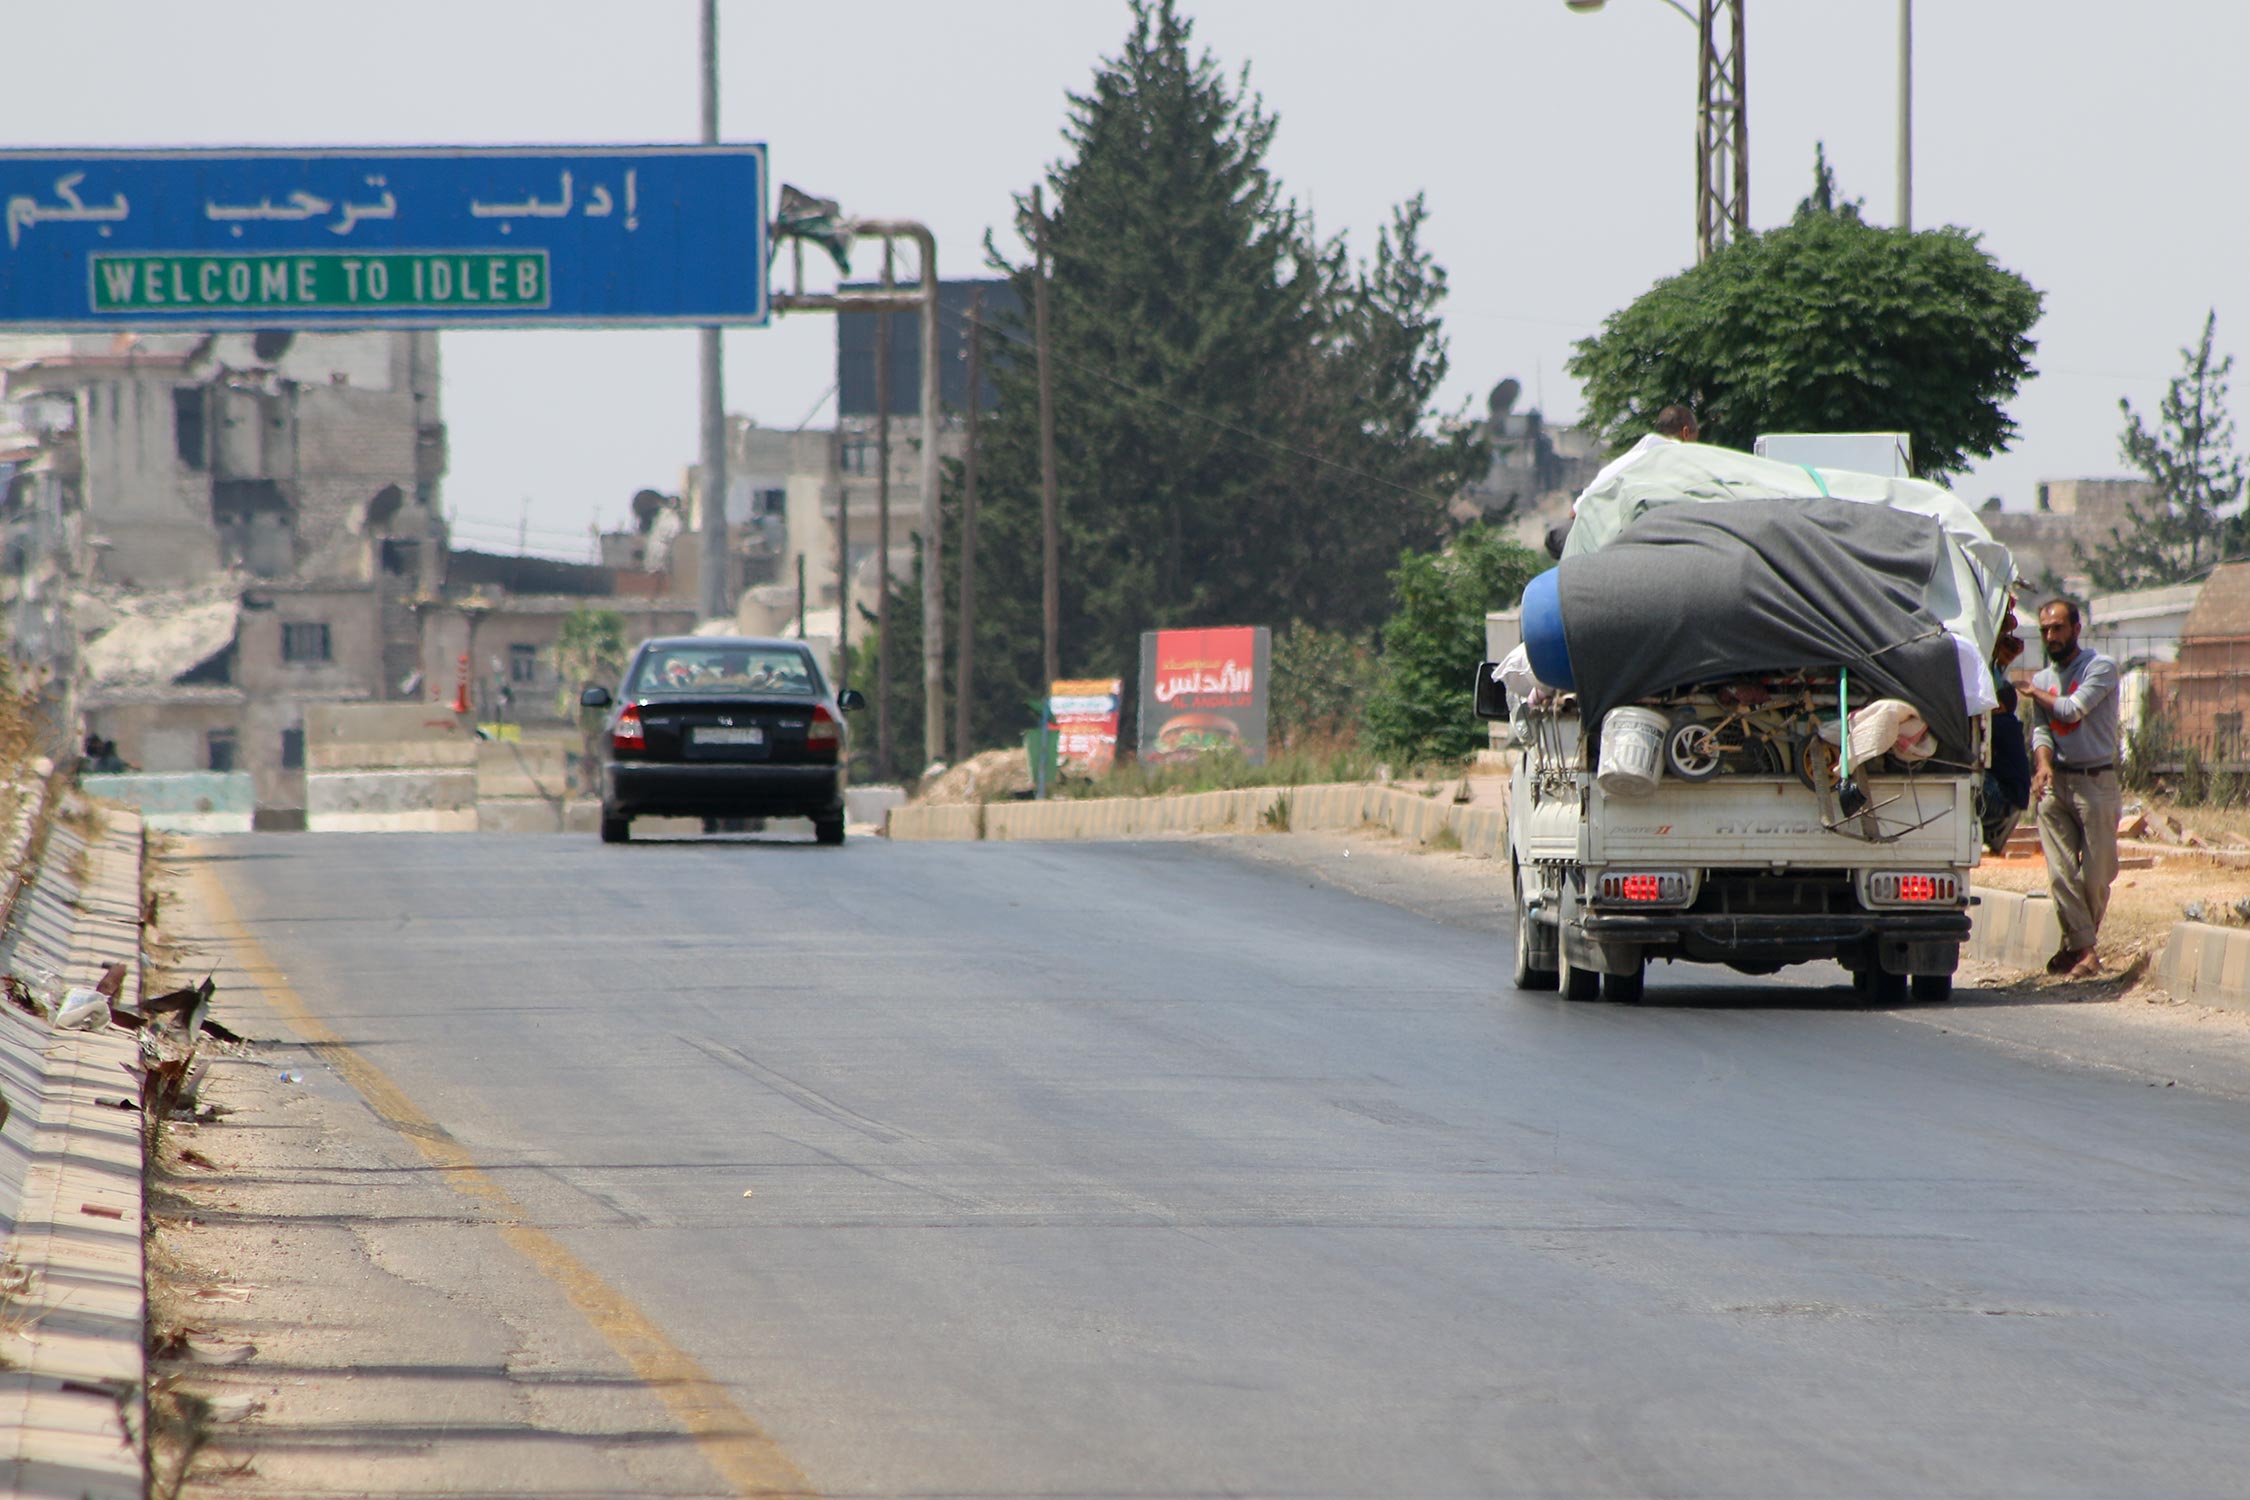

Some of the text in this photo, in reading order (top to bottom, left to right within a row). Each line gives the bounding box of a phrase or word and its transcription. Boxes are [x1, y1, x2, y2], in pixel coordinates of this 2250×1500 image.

[6, 168, 638, 249] إدلب ترحب بكم
[101, 259, 540, 303] WELCOME TO IDLEB
[1716, 819, 1834, 834] HYUNDA
